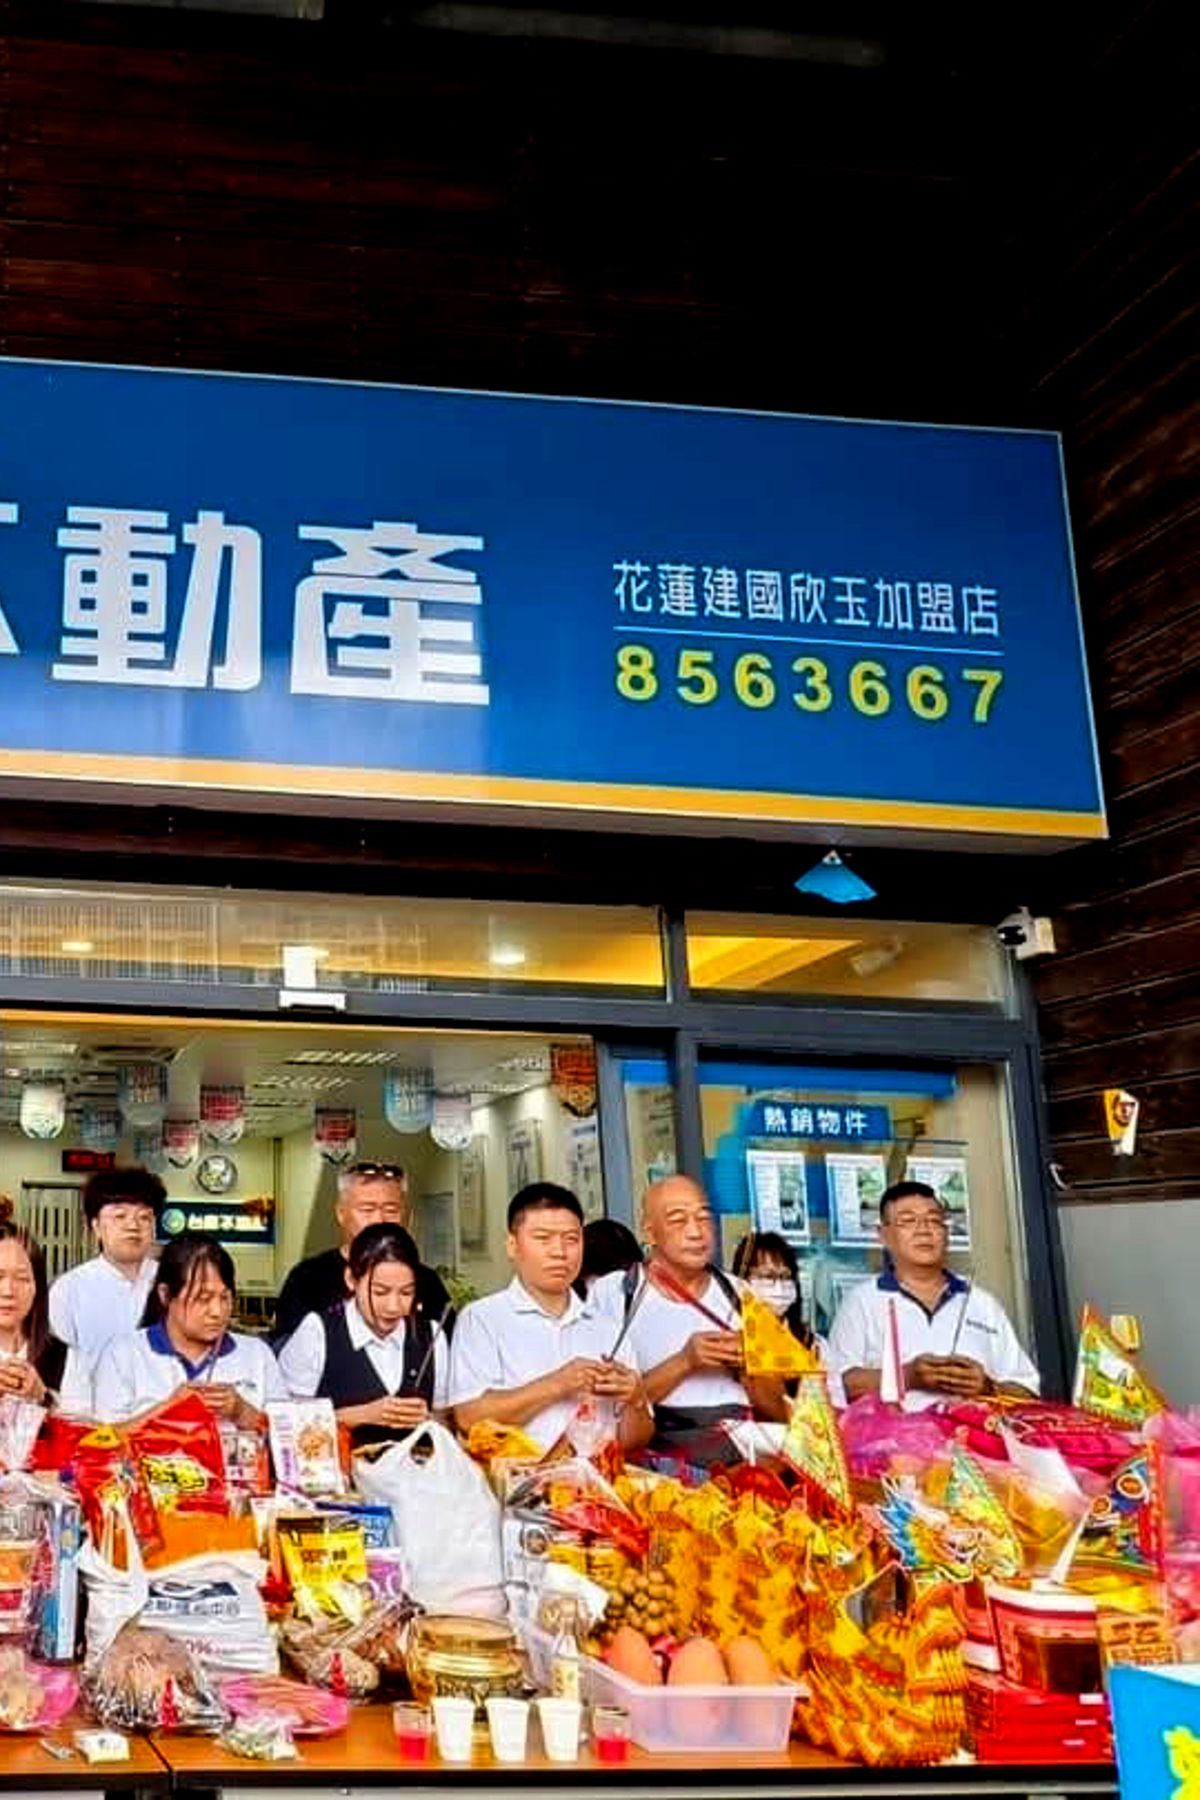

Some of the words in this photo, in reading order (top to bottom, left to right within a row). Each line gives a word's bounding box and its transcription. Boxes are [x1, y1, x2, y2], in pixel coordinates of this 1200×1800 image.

[612, 559, 1000, 637] 花蓮建國欣玉加盟店
[615, 644, 1004, 724] 8563667
[763, 1106, 869, 1136] 熱銷物件
